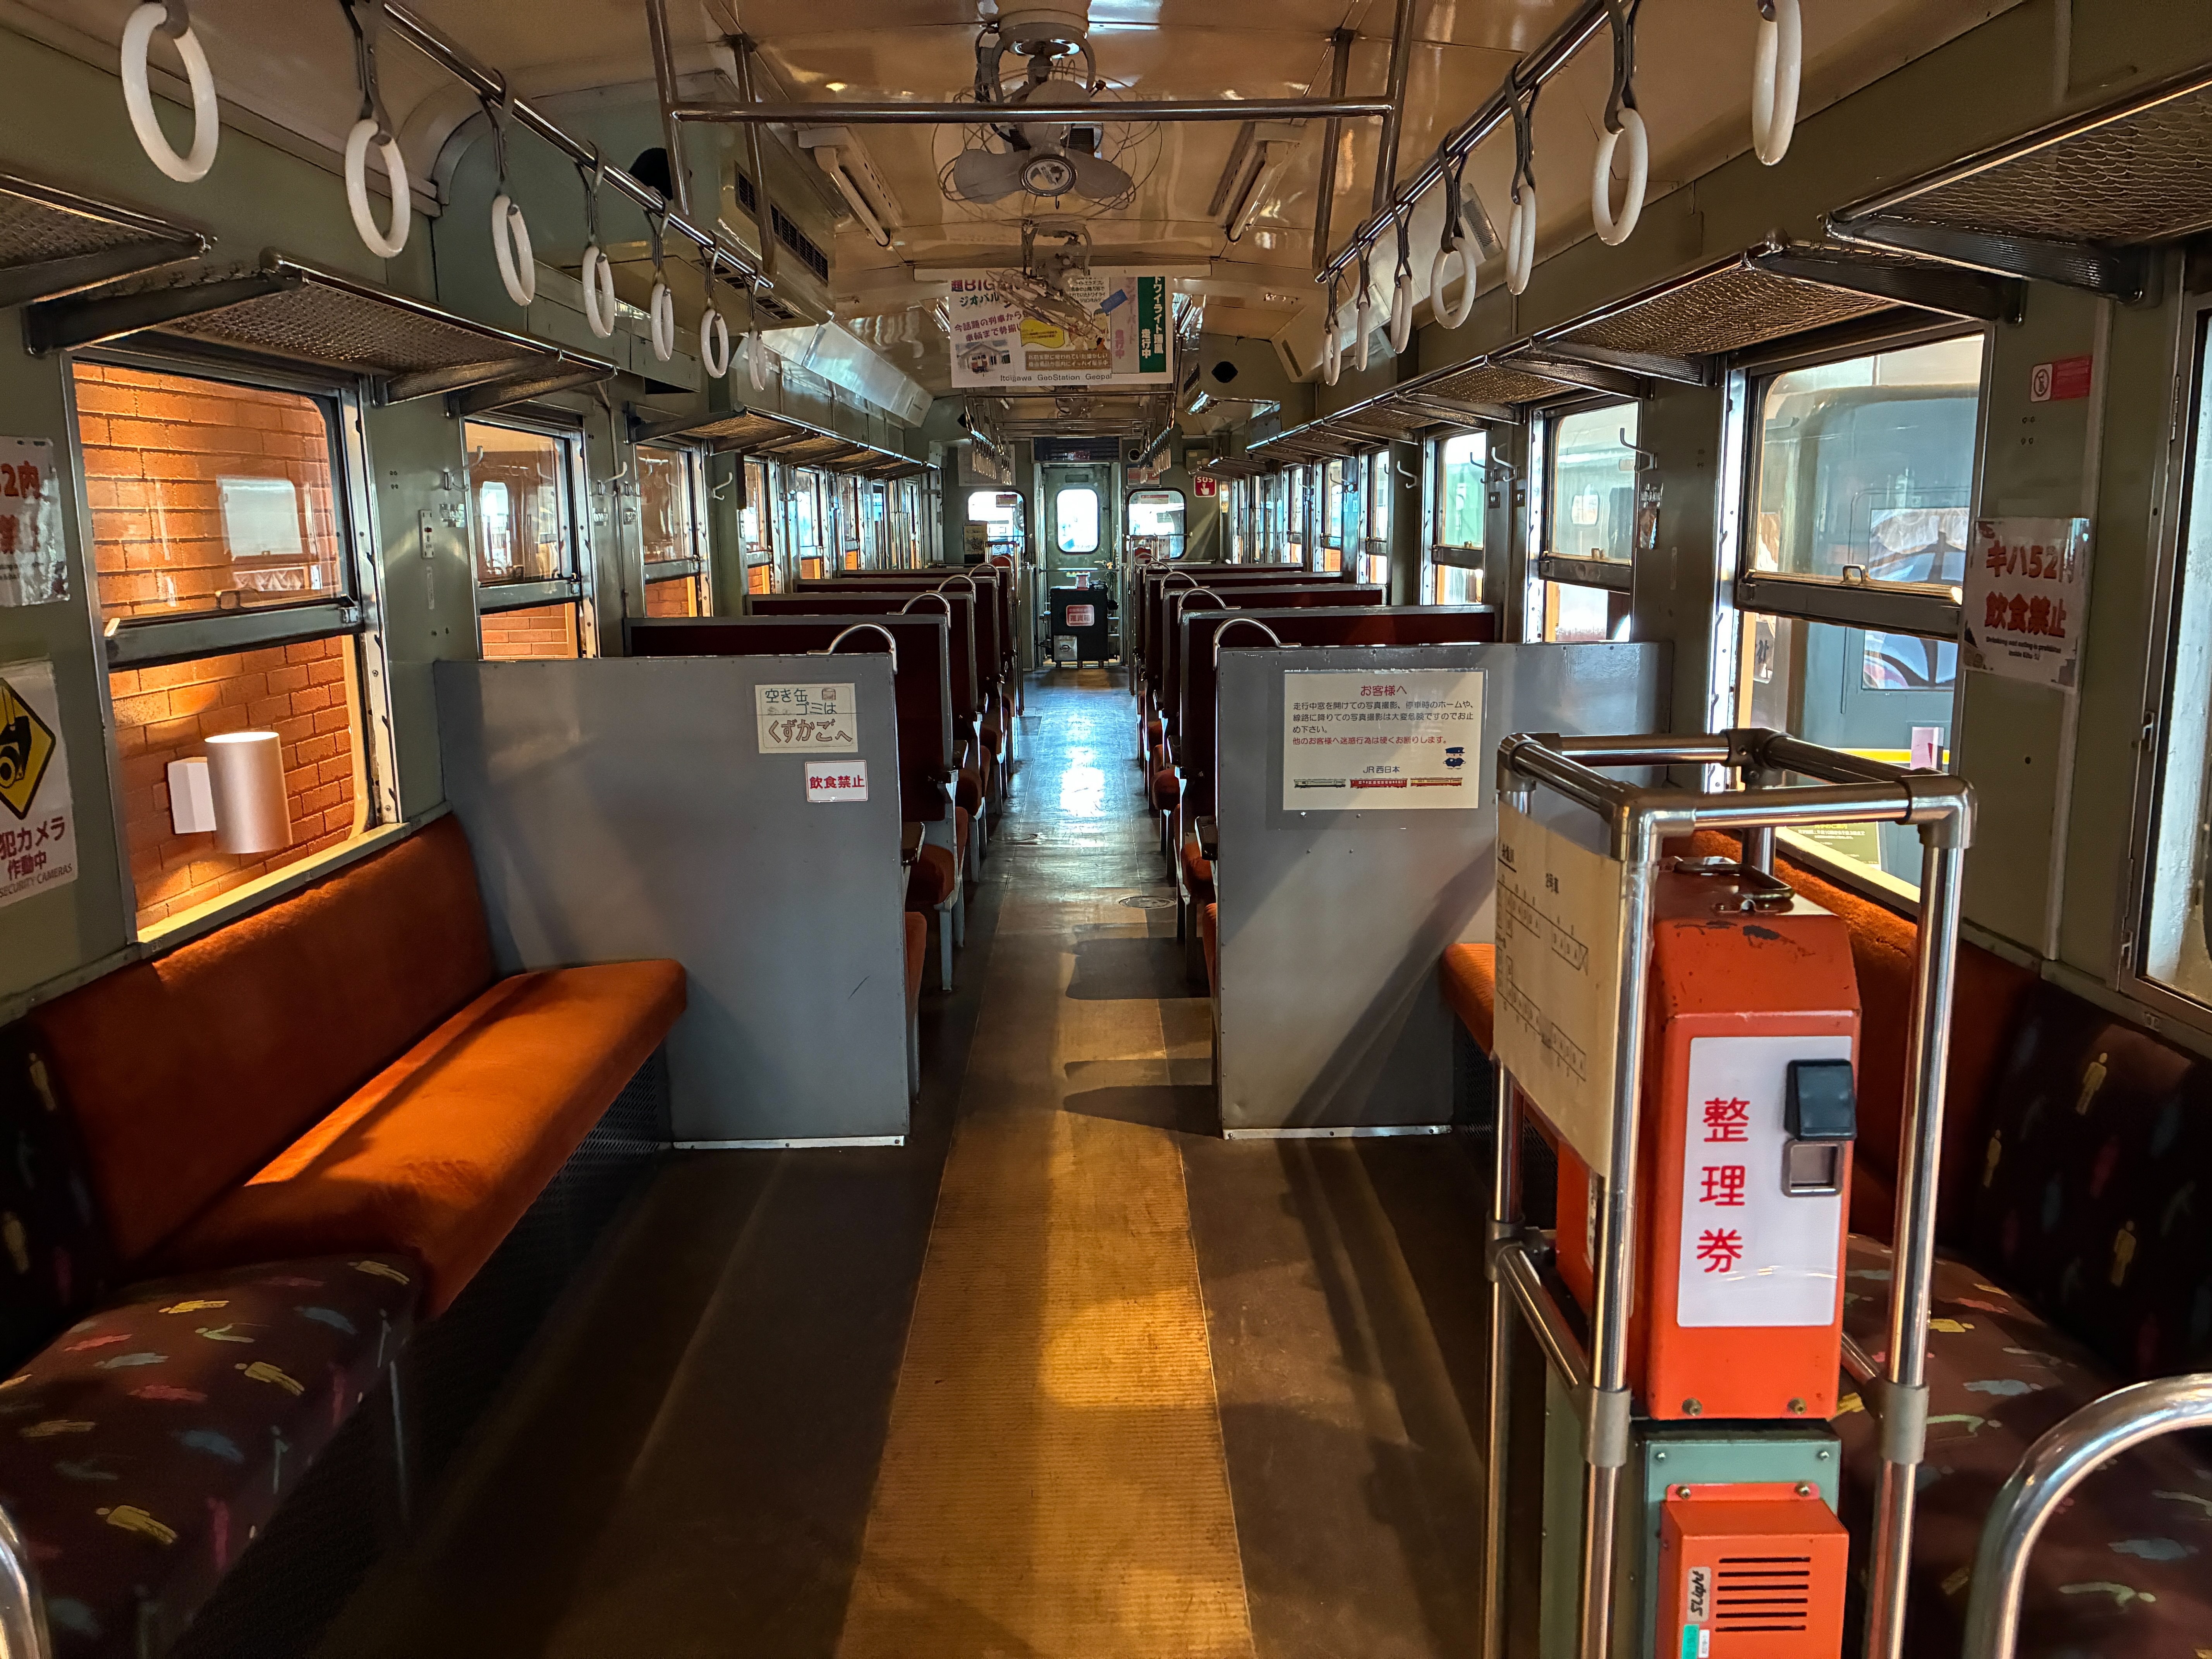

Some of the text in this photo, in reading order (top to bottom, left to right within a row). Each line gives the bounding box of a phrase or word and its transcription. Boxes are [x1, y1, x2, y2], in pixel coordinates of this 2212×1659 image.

[1985, 591, 2067, 638] 飲食禁止
[765, 688, 808, 703] 空き缶
[1360, 685, 1407, 696] お客様へ
[796, 701, 837, 715] ゴミは
[769, 718, 853, 743] くずかごへ
[1292, 725, 1328, 733] め下さい。
[809, 775, 865, 789] 飲食禁止
[37, 863, 72, 884] CAMERAS
[1697, 1097, 1750, 1273] 整理券
